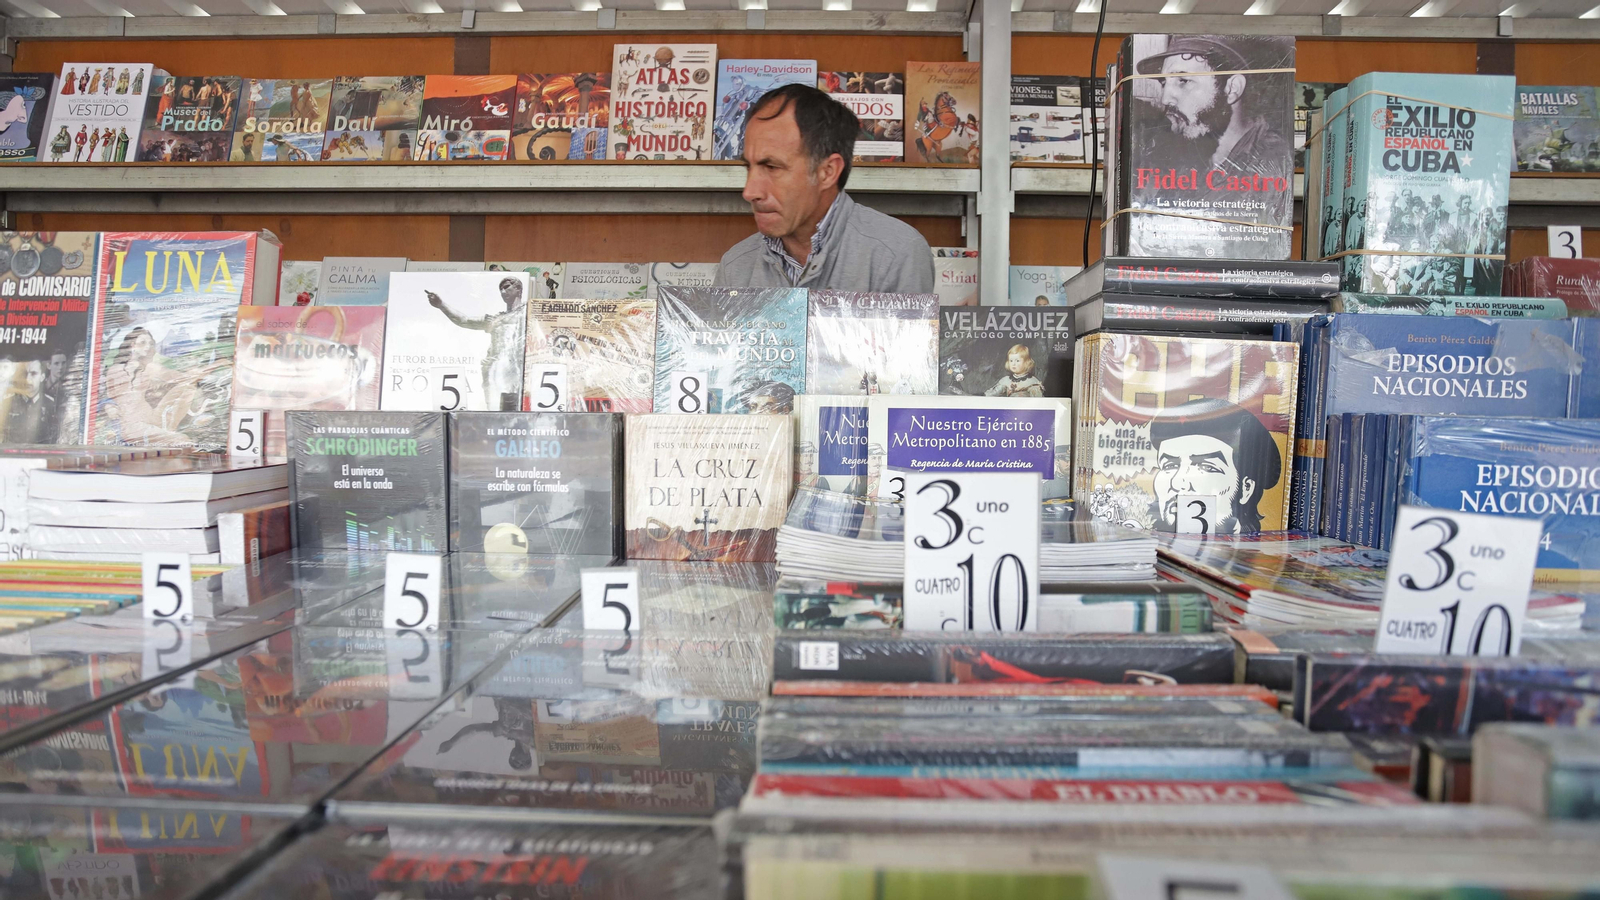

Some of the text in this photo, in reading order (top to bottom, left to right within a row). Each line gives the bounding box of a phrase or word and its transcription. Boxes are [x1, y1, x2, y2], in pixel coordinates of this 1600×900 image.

[636, 67, 691, 85] ATLAS
[726, 64, 812, 75] Harley-Davidson
[614, 96, 707, 118] HISTÓRICO
[1386, 95, 1402, 105] EL
[1520, 93, 1579, 105] BATALLAS
[69, 104, 129, 117] VESTIDO
[164, 108, 198, 116] Museo
[1386, 105, 1476, 129] EXILIO
[1522, 106, 1559, 115] NAVALES
[161, 116, 223, 131] Prado
[244, 117, 322, 133] Sorolla
[333, 115, 378, 132] Dalí
[422, 114, 473, 132] Miró
[531, 112, 598, 129] Gaudí
[1385, 128, 1474, 140] REPUBLICANO
[627, 134, 691, 152] MUNDO
[1384, 135, 1473, 151] ESPAÑOL EN
[1382, 149, 1461, 173] CUBA
[1136, 168, 1288, 192] Fidel Castro
[1156, 197, 1267, 210] La victoria estratégica
[1217, 234, 1243, 242] Santiago
[1557, 231, 1577, 259] 3
[110, 250, 238, 294] LUNA
[328, 273, 377, 284] CALMA
[571, 275, 642, 285] PSICOLÓGICAS
[1016, 269, 1047, 284] Yoga
[1117, 265, 1218, 282] Fidel Castro
[1232, 269, 1258, 277] victoria
[1258, 270, 1294, 278] estratégica
[2, 276, 92, 297] de COMISARIO
[8, 297, 90, 312] Intervención Militar
[856, 297, 928, 312] Cruzadas
[1228, 308, 1253, 316] victoria
[1455, 307, 1489, 316] ESPAÑOL
[6, 312, 58, 326] División Azul
[944, 306, 1069, 332] VELÁZQUEZ
[1116, 306, 1215, 321] Fidel Castro
[256, 319, 293, 329] el sabor
[690, 328, 794, 346] TRAVESÍA AL
[1009, 331, 1069, 339] COMPLETO
[1407, 333, 1466, 345] Benito Pérez
[254, 342, 358, 360] marruecos
[716, 347, 796, 362] MUNDO
[391, 355, 426, 364] FUROR
[1386, 353, 1517, 377] EPISODIOS
[391, 374, 474, 394] ROA
[1372, 376, 1528, 400] NACIONALES
[439, 374, 461, 411] 5
[313, 425, 410, 435] LAS PARADOJAS CUÁNTICAS
[487, 428, 570, 437] EL MÉTODO CIENTÍFICO
[909, 415, 1034, 435] Nuestro Ejército
[1115, 428, 1136, 439] una
[305, 434, 419, 456] SCHRÖDINGER
[494, 440, 562, 459] GALILEO
[677, 441, 761, 450] VILLANUEVA JIMÉNEZ
[891, 432, 1052, 452] Metropolitano en 1885
[1098, 434, 1151, 453] biografía
[910, 459, 1034, 472] Regencia de María Cristina
[1103, 450, 1146, 468] gráfica
[341, 464, 384, 477] El universo
[495, 467, 561, 480] La naturaleza se
[653, 458, 760, 479] LA CRUZ
[333, 477, 393, 490] está en la onda
[487, 480, 569, 493] escribe con fórmulas
[649, 486, 765, 508] DE PLATA
[1291, 470, 1300, 526] NACIONALES
[1309, 472, 1319, 531] NACIONALES
[914, 479, 1010, 551] 3 uno
[1186, 499, 1209, 534] 3
[1398, 516, 1506, 592] 3 uno
[915, 553, 1029, 631] CUATRO 10
[602, 583, 632, 631] 5
[1386, 599, 1512, 657] CUATRO 10
[1054, 785, 1258, 801] EL DIABLO
[368, 856, 589, 885] EINSTEIN
